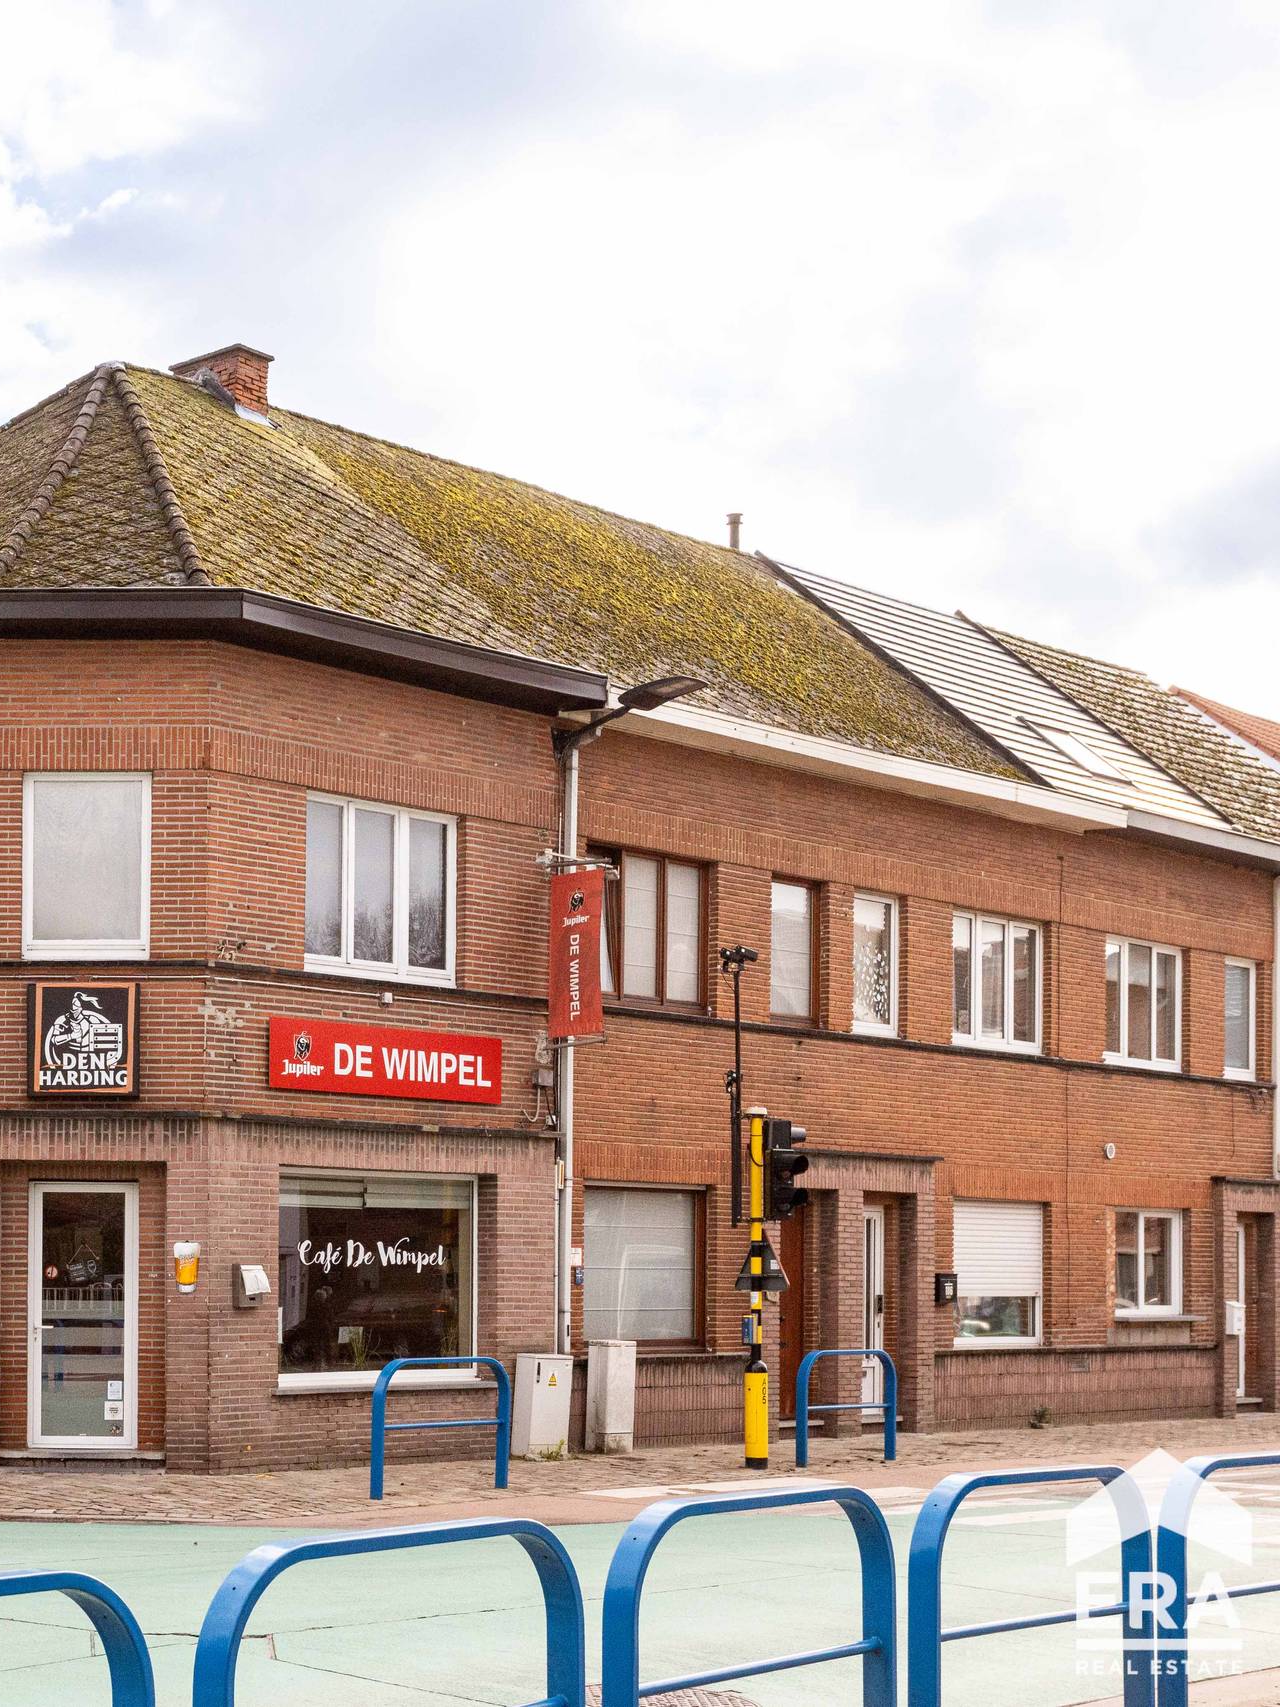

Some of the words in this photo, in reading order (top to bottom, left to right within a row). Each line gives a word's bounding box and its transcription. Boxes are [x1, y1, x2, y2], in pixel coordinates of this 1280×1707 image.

[562, 915, 590, 927] Jupiler
[569, 934, 580, 955] DE
[569, 959, 581, 1021] WIMPEL
[62, 1052, 105, 1070] DEN
[280, 1058, 325, 1078] Jupiler
[333, 1042, 374, 1078] DE
[381, 1047, 492, 1088] WIMPEL
[39, 1070, 128, 1086] HARDING
[297, 1239, 343, 1274] Café
[346, 1239, 376, 1268] De
[376, 1237, 447, 1274] Wimpel
